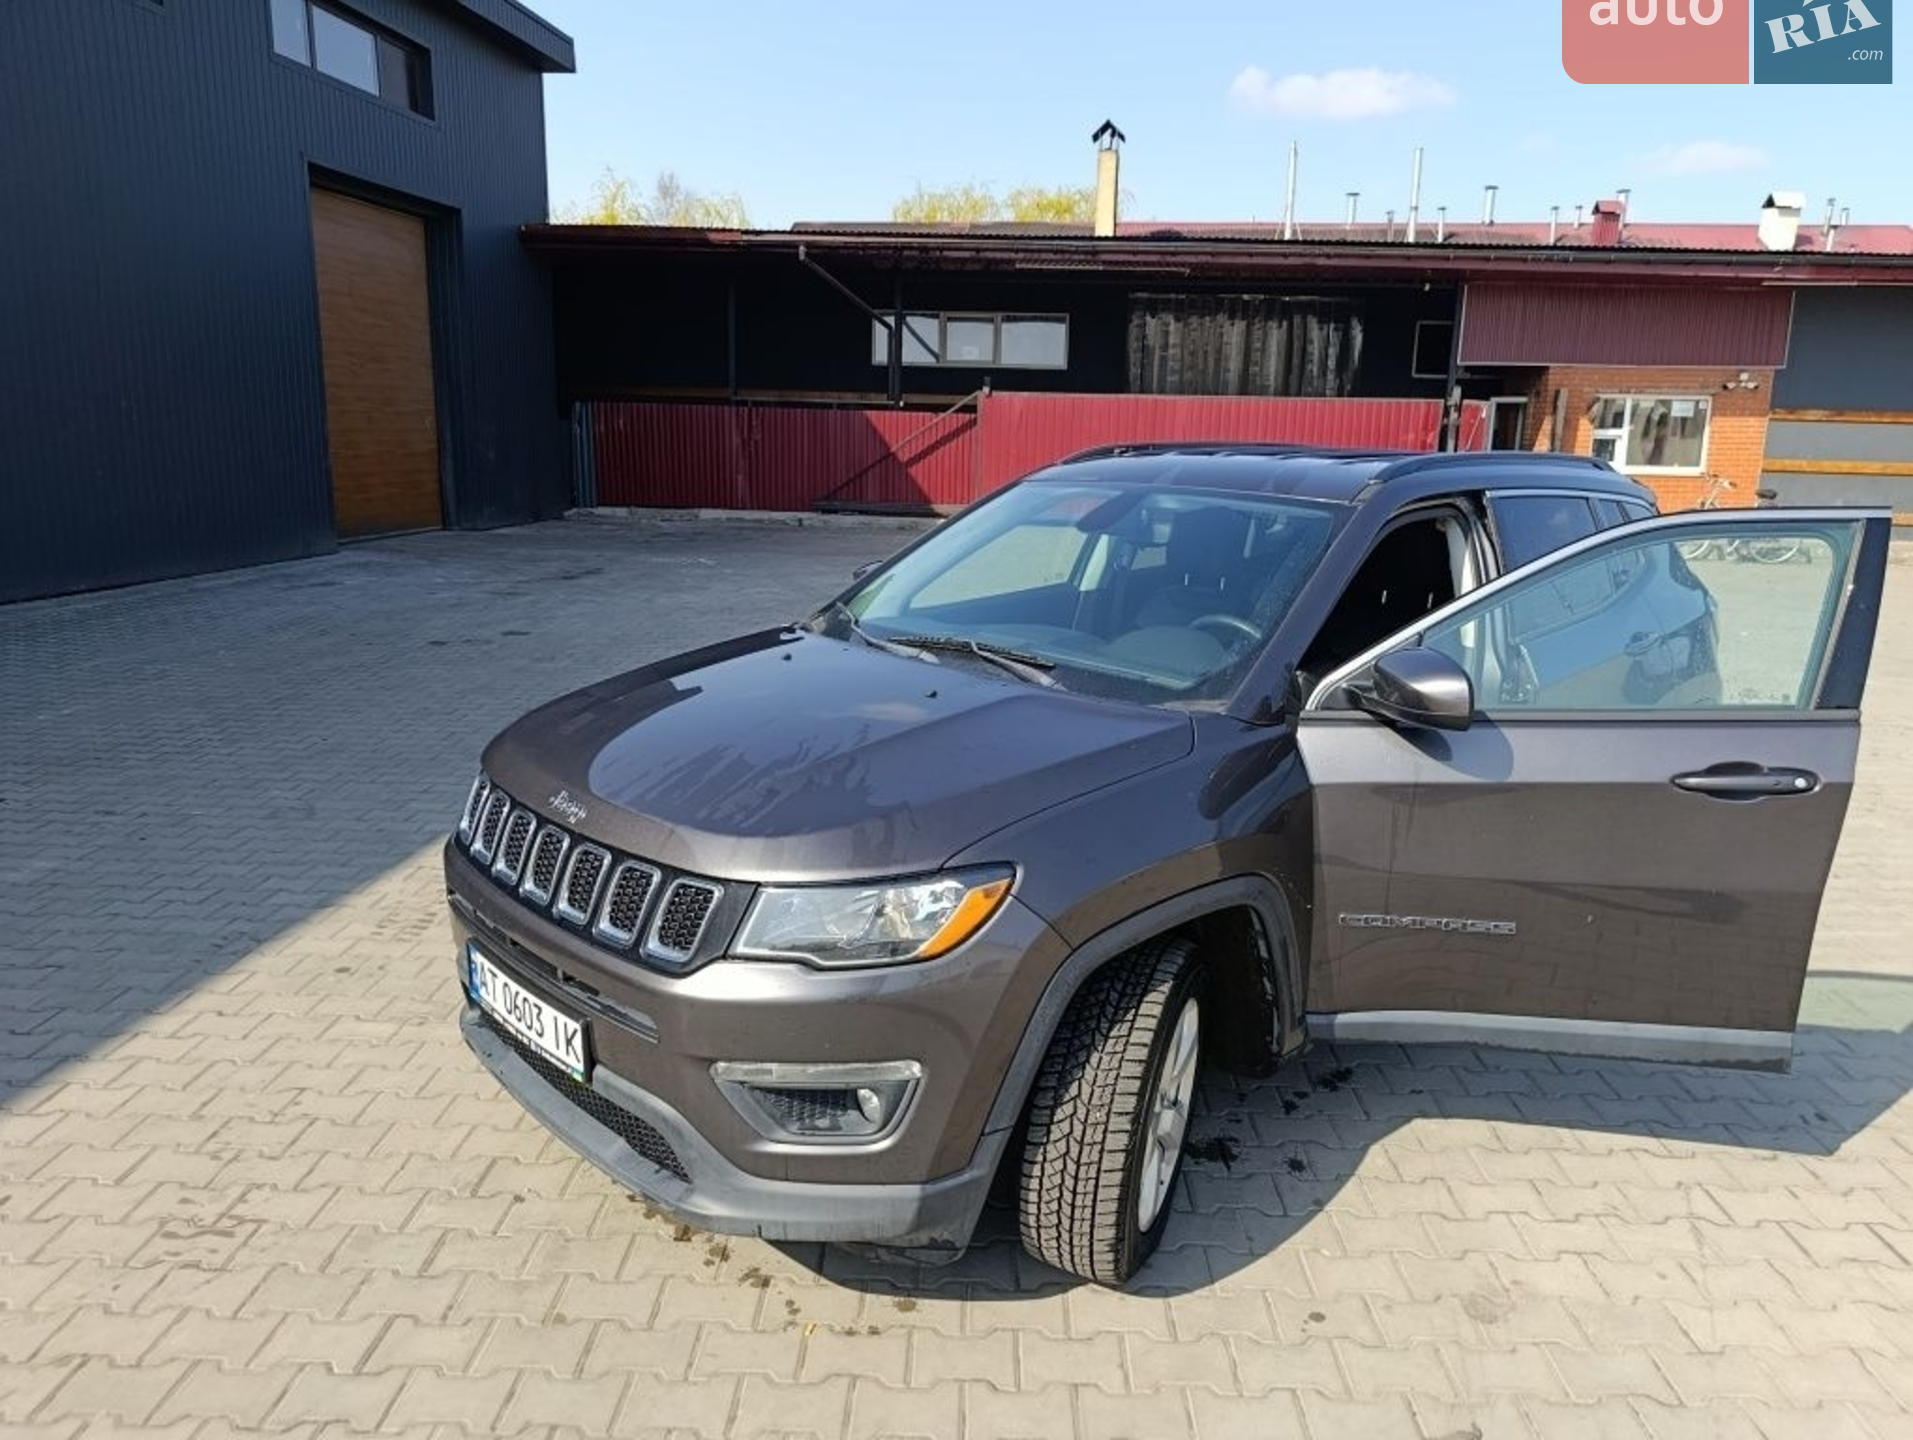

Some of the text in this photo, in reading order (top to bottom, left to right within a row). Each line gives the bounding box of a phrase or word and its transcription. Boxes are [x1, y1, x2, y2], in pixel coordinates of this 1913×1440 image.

[480, 961, 581, 1064] AT 0603 IK
